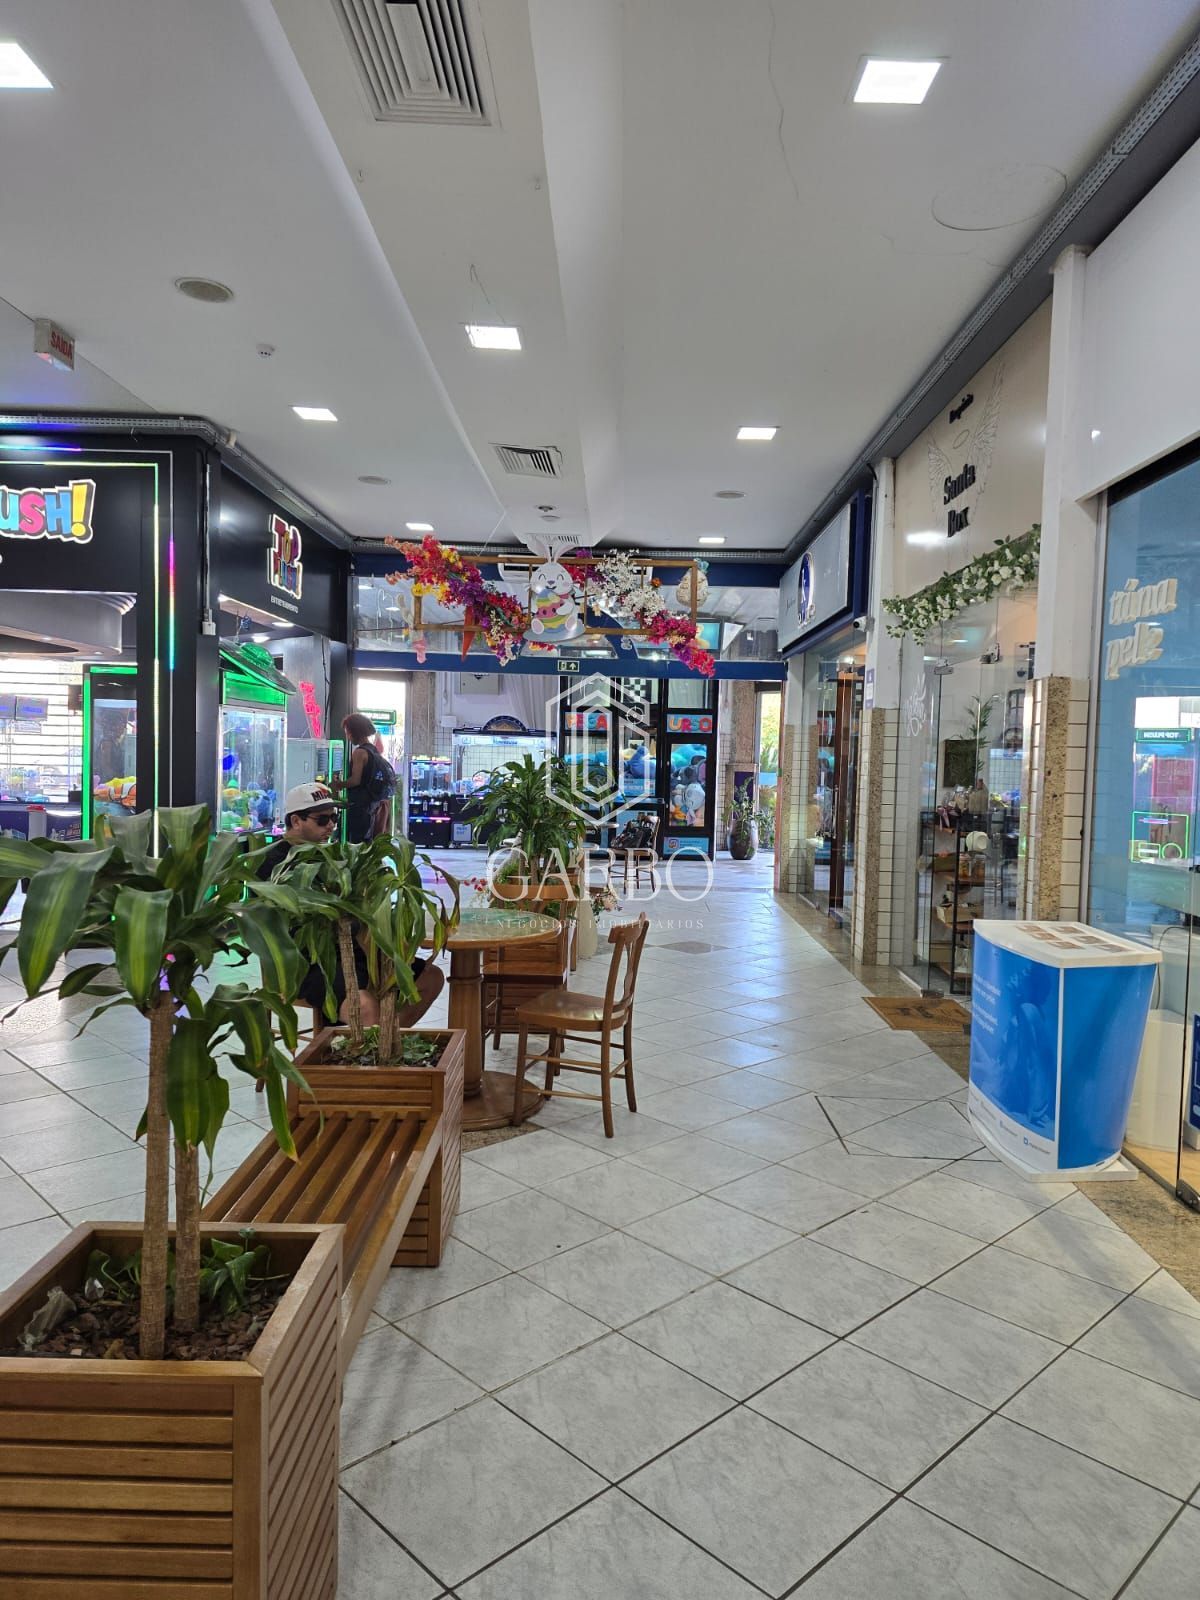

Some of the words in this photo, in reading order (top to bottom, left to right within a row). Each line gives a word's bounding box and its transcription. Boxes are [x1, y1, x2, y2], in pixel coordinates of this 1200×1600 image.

[944, 463, 976, 505] Santa
[272, 515, 301, 564] TOP
[948, 507, 970, 538] Box
[669, 717, 712, 732] URSO
